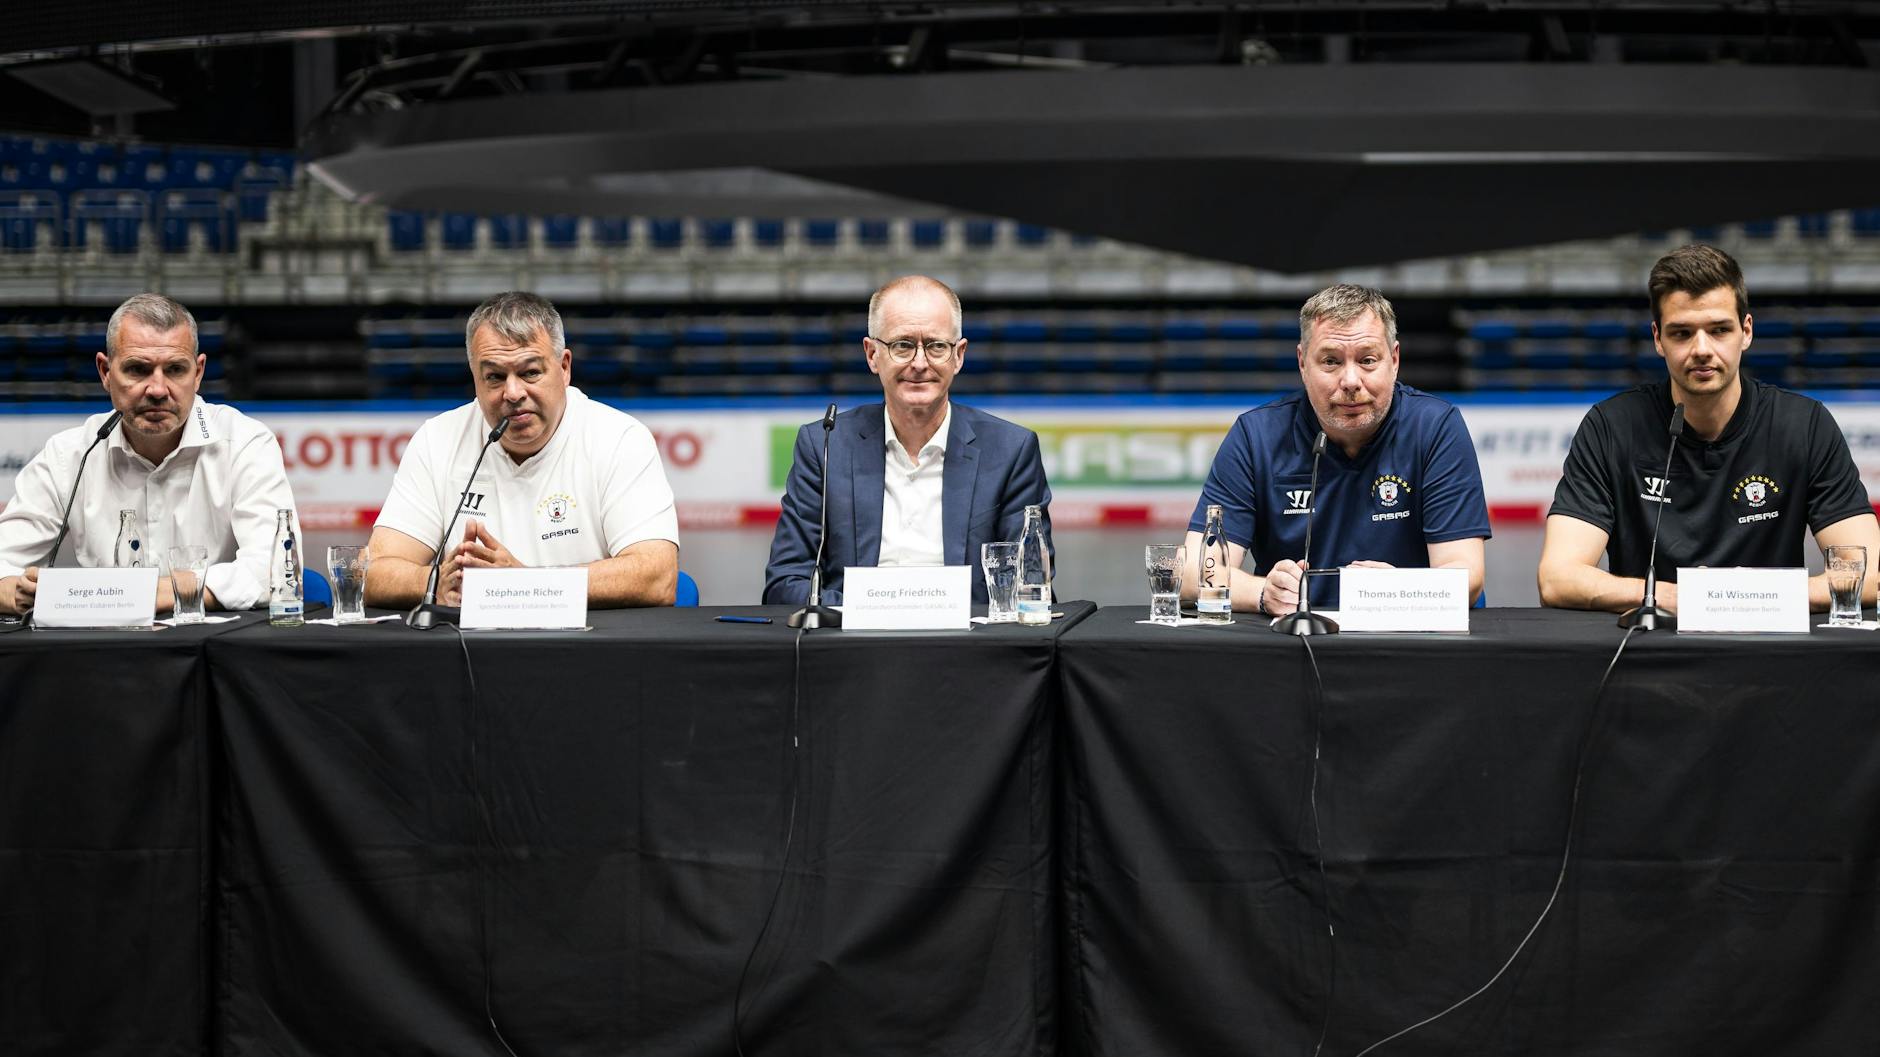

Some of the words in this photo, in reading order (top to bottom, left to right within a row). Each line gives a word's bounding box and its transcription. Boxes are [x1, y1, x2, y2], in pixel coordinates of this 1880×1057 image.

[196, 406, 210, 439] GASAG
[1372, 510, 1410, 521] GASAG
[1738, 510, 1779, 524] GASAG
[541, 528, 579, 541] GASAG
[68, 587, 94, 598] Serge
[96, 587, 124, 596] Aubin
[485, 587, 531, 598] Stéphane
[533, 588, 564, 597] Richer
[867, 588, 897, 599] Georg
[899, 587, 947, 597] Friedrichs
[1358, 590, 1397, 599] Thomas
[1400, 589, 1451, 599] Bothstede
[1707, 590, 1723, 599] Kai
[1726, 590, 1778, 599] Wissmann
